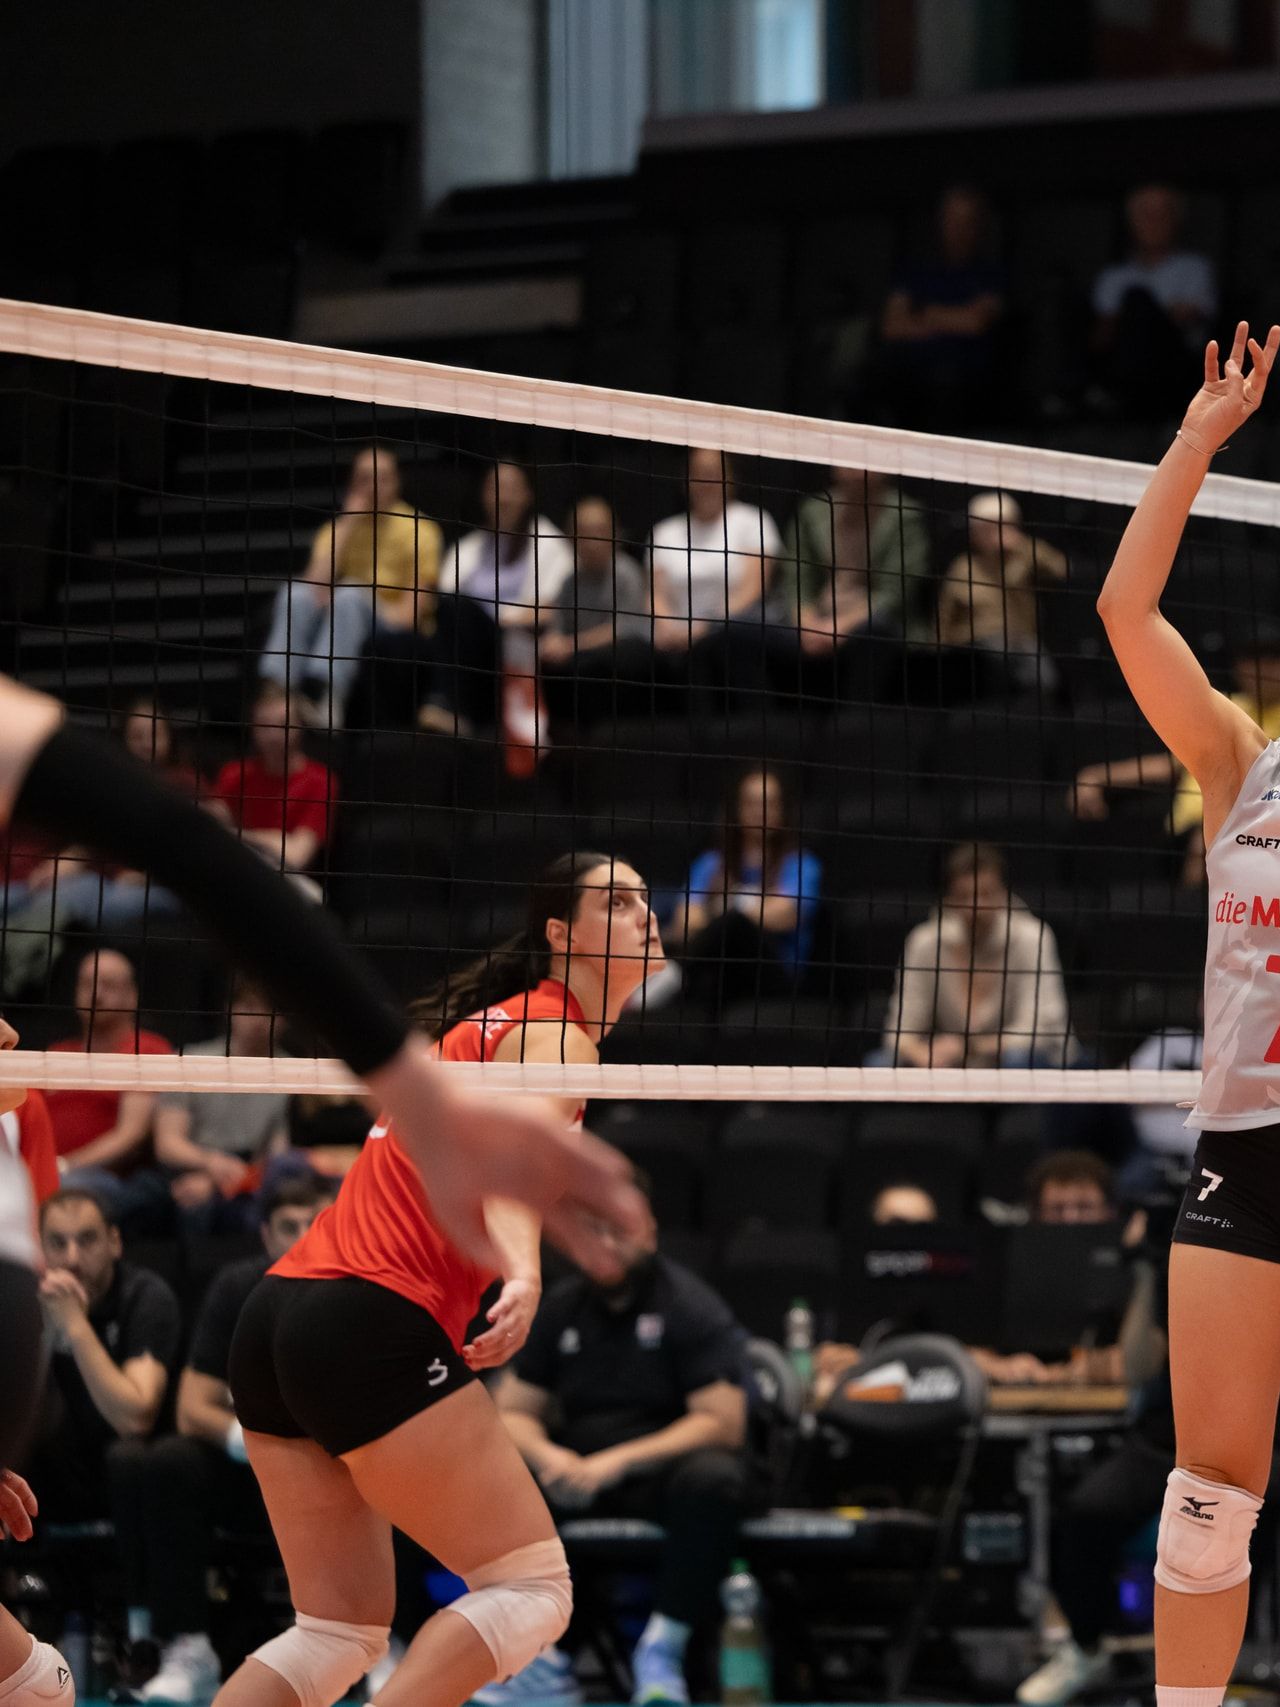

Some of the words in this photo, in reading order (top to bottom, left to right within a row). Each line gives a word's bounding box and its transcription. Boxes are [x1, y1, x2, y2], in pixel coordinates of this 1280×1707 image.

[1216, 891, 1247, 925] die
[1197, 1167, 1224, 1201] 7
[1185, 1211, 1222, 1225] CRAFT
